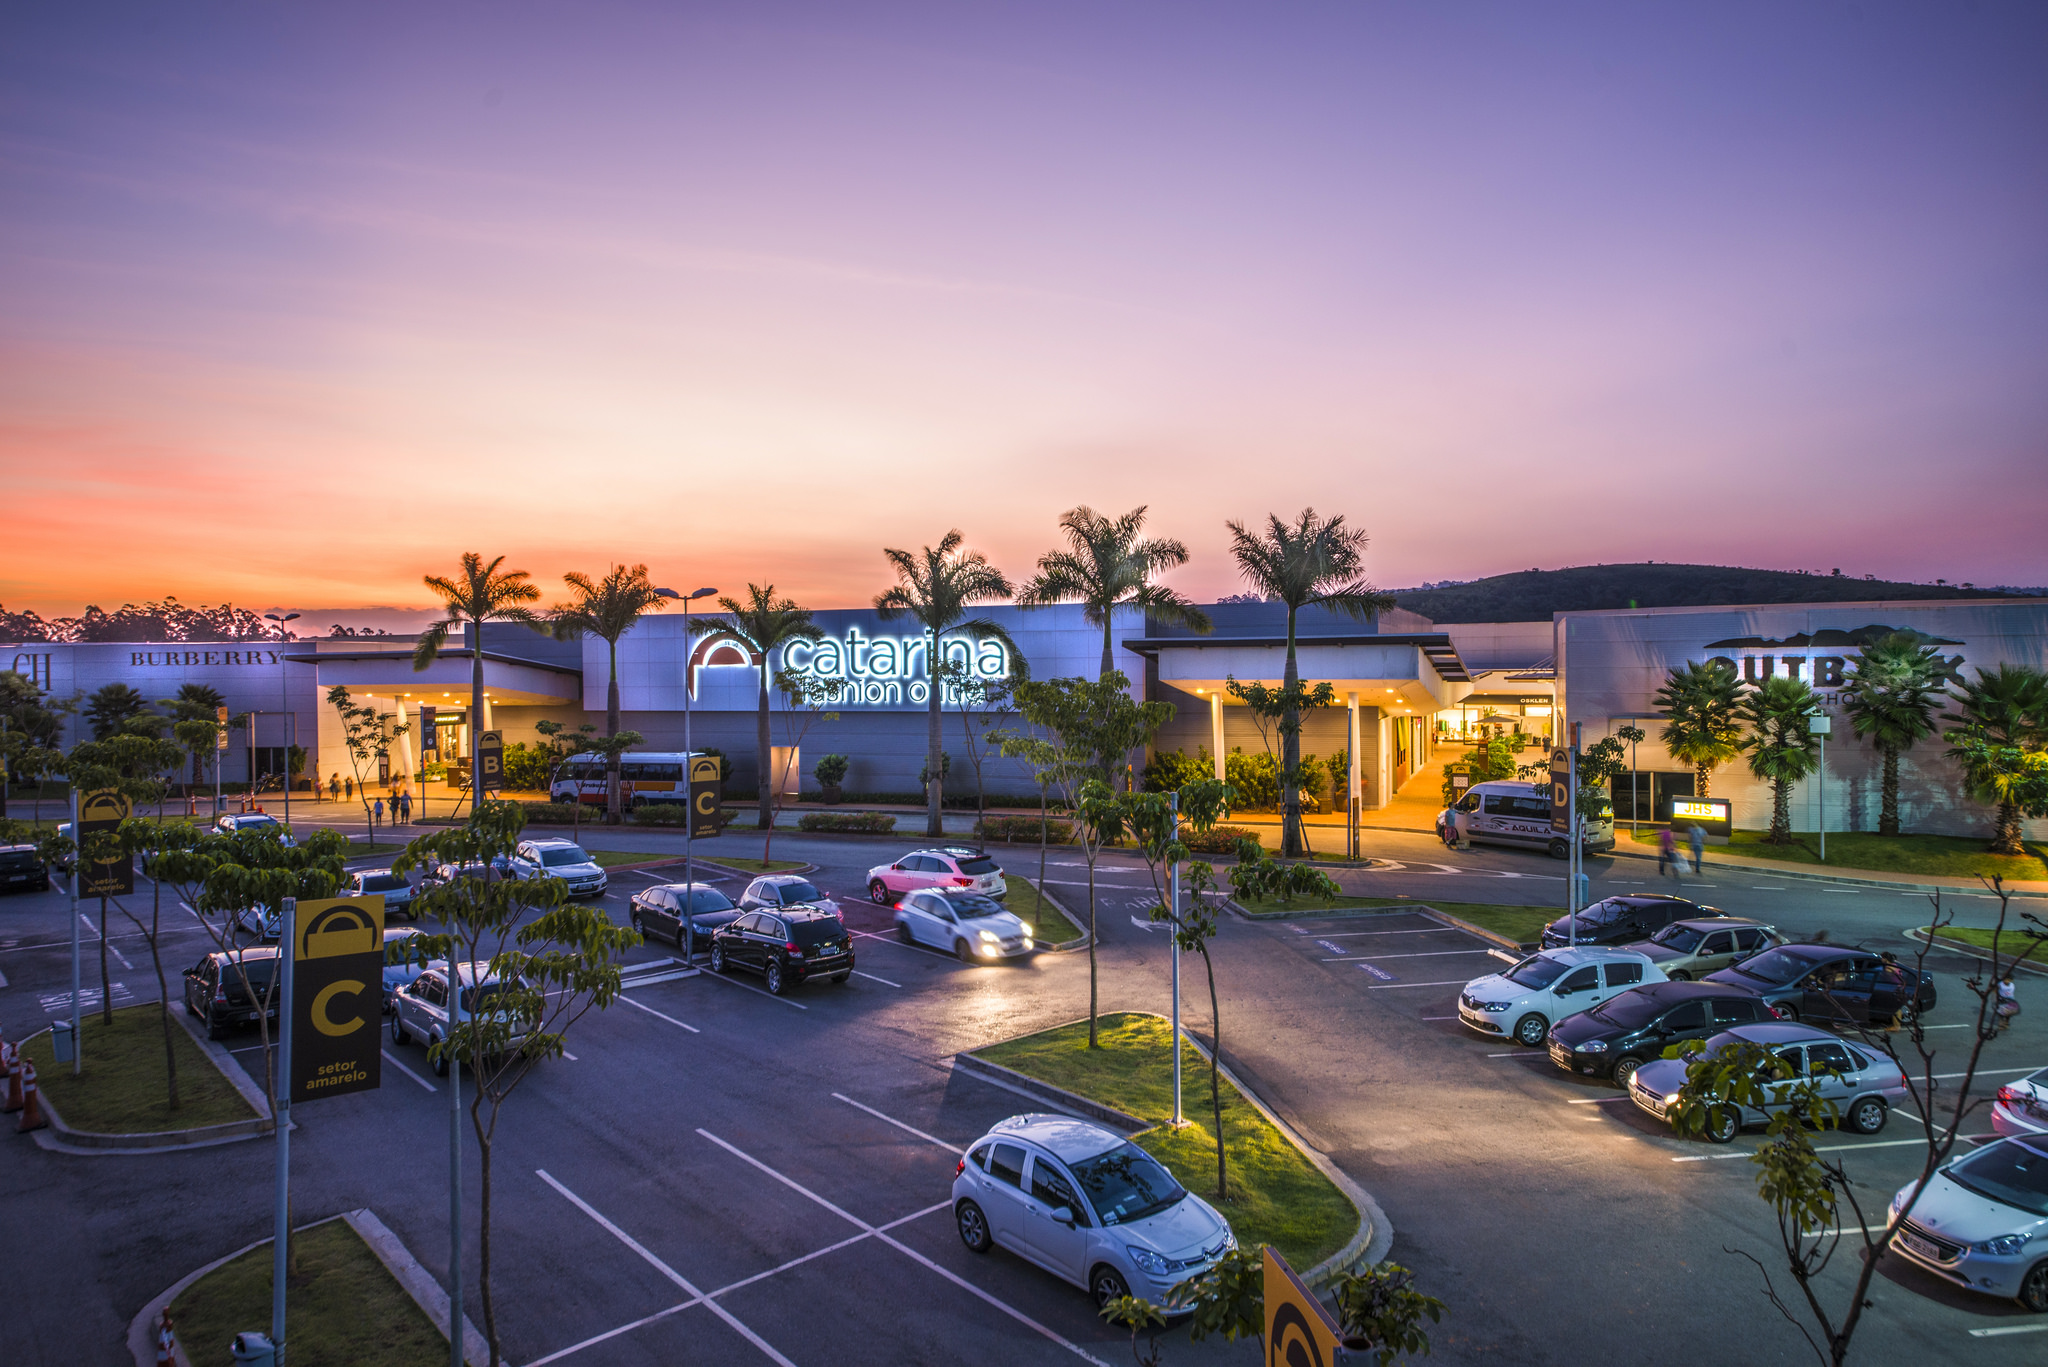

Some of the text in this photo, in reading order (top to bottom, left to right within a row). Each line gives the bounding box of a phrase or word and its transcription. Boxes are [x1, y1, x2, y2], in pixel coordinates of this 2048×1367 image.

[131, 651, 283, 666] BURBERRY
[783, 629, 1005, 675] catarina
[1704, 656, 1966, 688] OUTBK
[483, 756, 499, 774] B
[696, 791, 716, 815] C
[1554, 782, 1568, 807] D
[1684, 802, 1712, 814] JHS
[1512, 825, 1551, 834] AQUILA
[310, 979, 366, 1037] C
[318, 1060, 357, 1075] setor
[306, 1070, 367, 1089] amarelo
